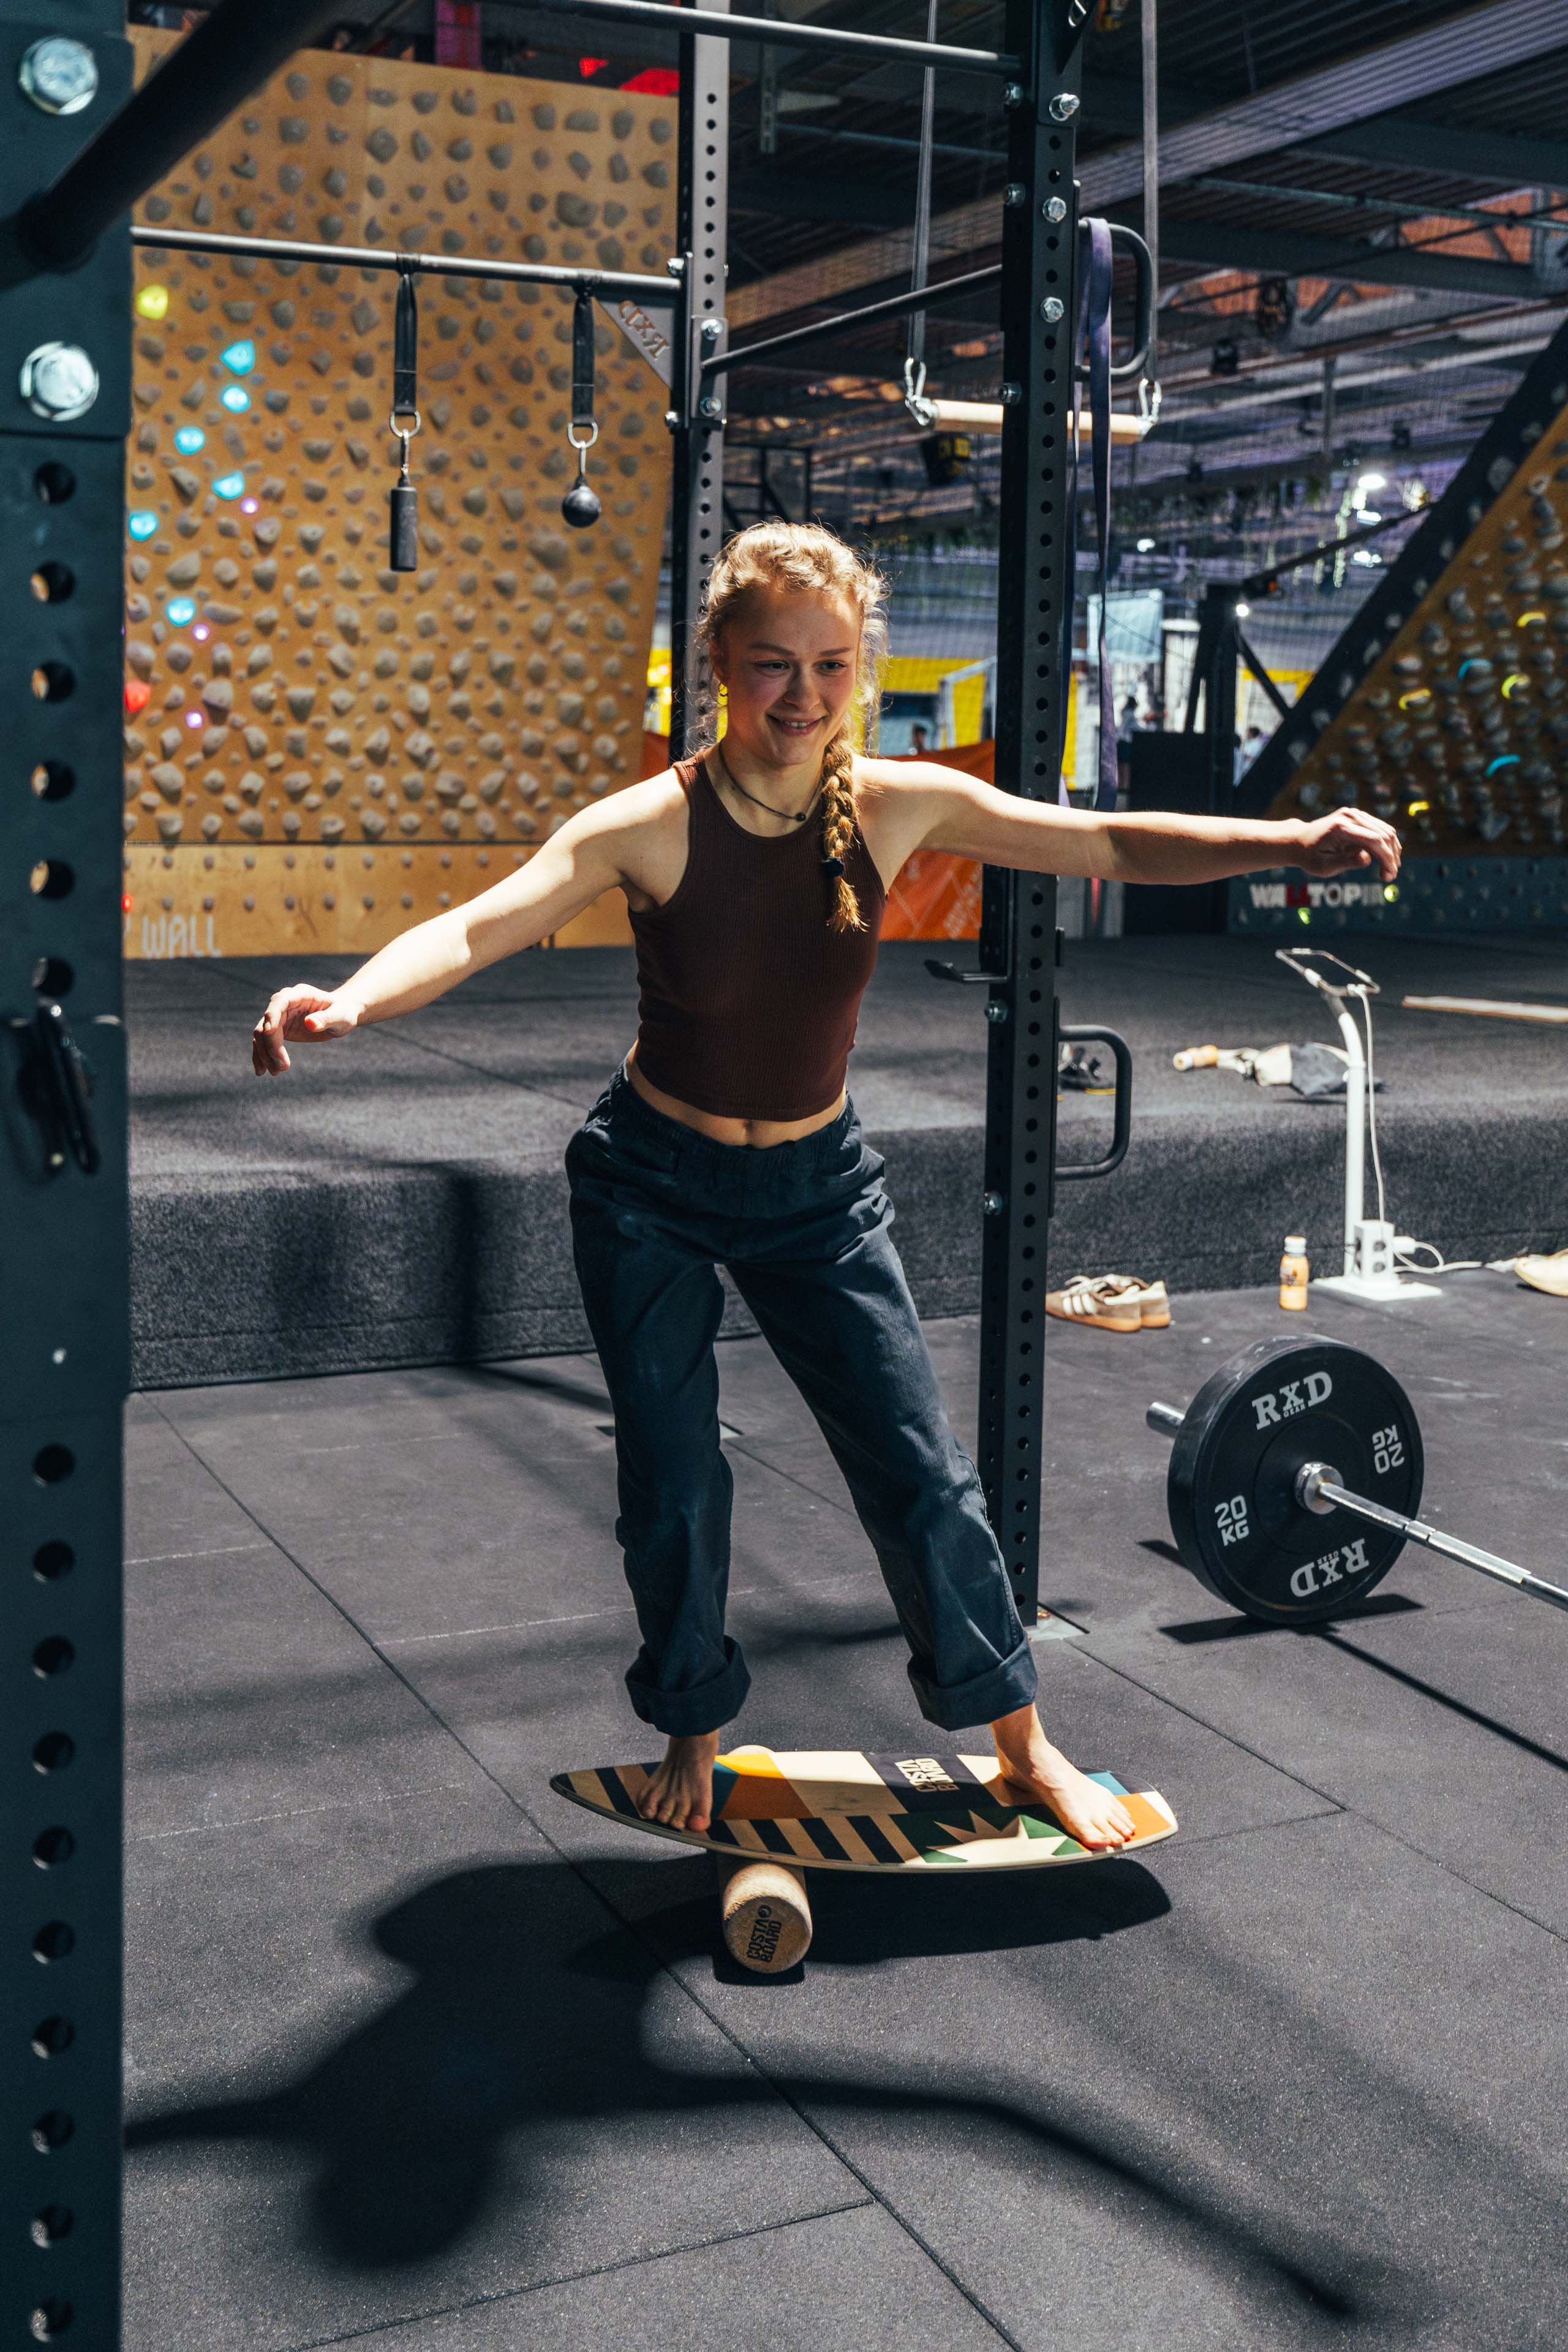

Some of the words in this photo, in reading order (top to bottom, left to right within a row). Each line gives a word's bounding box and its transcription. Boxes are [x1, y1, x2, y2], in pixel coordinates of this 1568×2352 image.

[141, 913, 222, 960] WALL
[1251, 1371, 1332, 1430] RXD
[1283, 1403, 1306, 1418] GEAR
[1371, 1424, 1398, 1451] KG
[1374, 1442, 1404, 1474] 20
[1214, 1495, 1247, 1528] 20
[1221, 1518, 1250, 1547] KG
[1290, 1538, 1370, 1597] RXD
[894, 1759, 938, 1792] COSTA
[914, 1758, 960, 1791] BOARD
[747, 1918, 768, 1960] COSTA
[760, 1920, 782, 1963] BOARD
